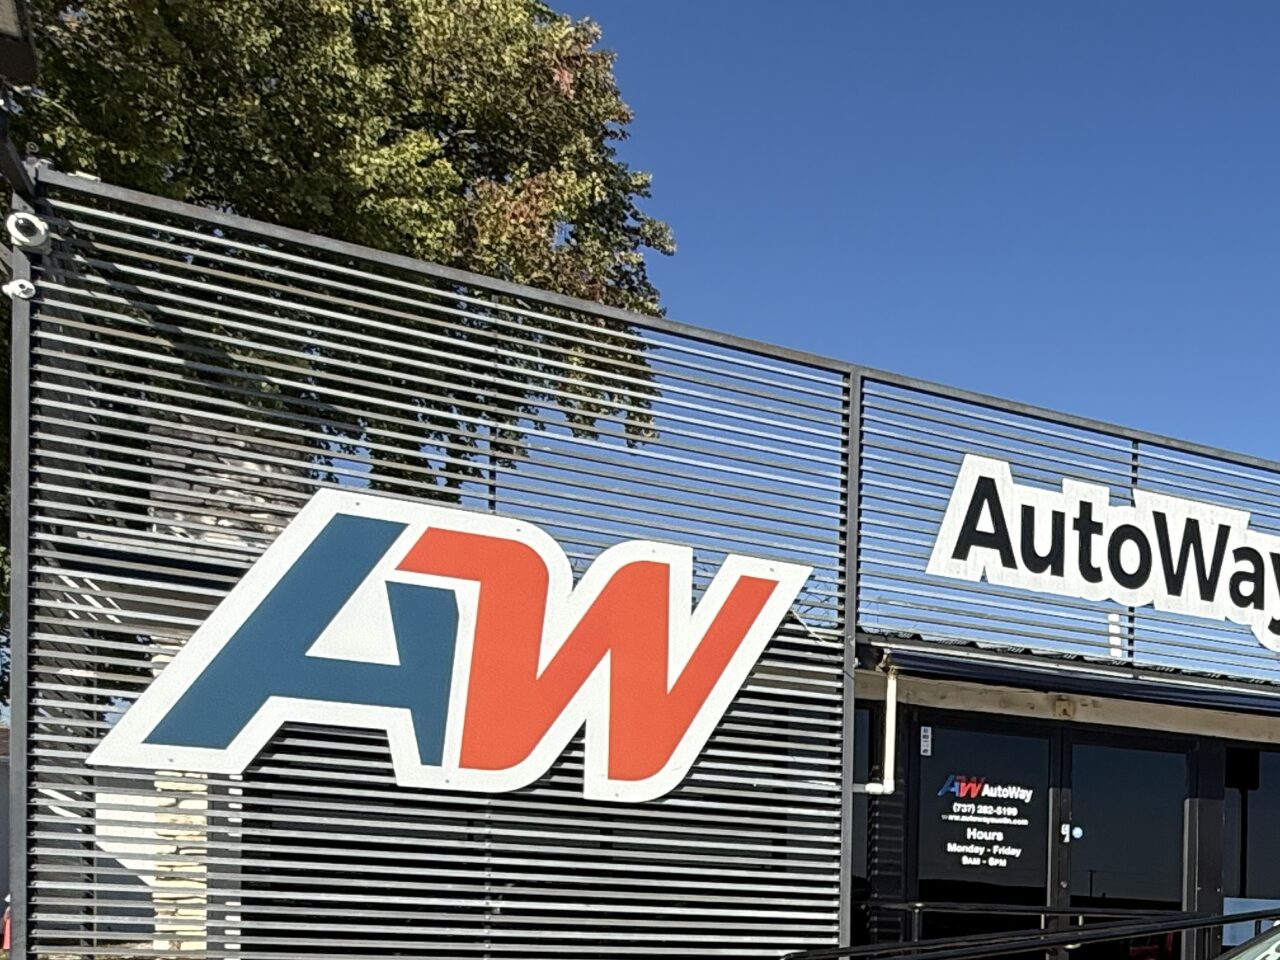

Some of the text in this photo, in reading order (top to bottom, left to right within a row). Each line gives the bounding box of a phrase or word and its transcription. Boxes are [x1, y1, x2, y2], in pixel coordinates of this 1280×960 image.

[141, 511, 780, 781] AW
[982, 783, 1033, 803] AutoWay
[952, 802, 976, 814] (737)
[966, 827, 1004, 841] Hours
[947, 842, 985, 855] Monday
[992, 845, 1022, 858] Friday
